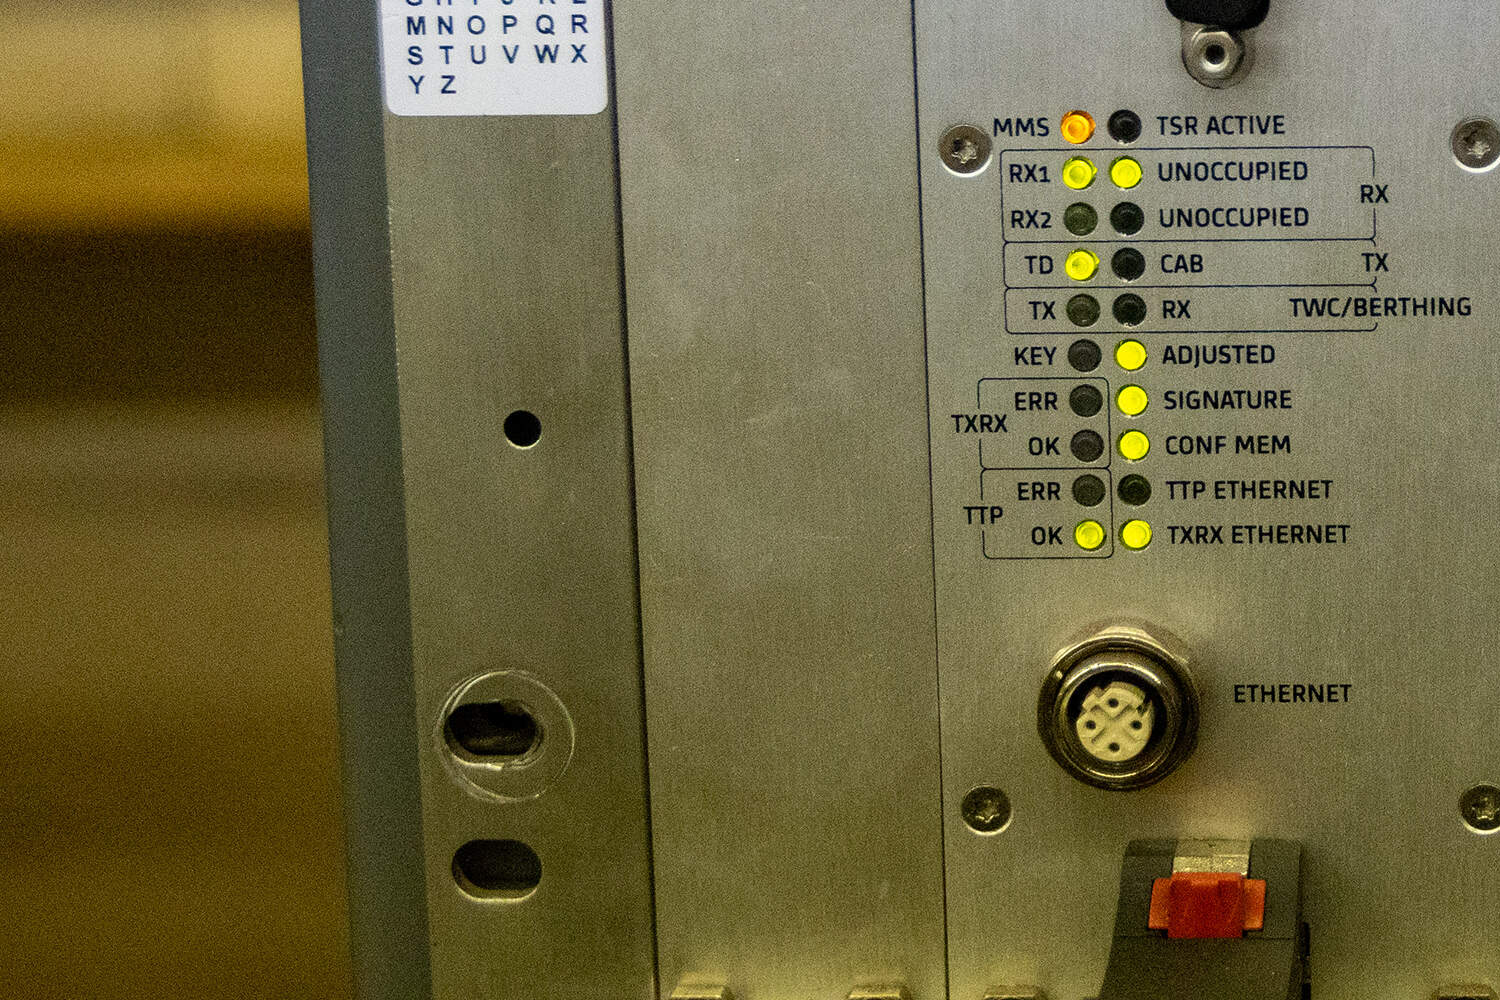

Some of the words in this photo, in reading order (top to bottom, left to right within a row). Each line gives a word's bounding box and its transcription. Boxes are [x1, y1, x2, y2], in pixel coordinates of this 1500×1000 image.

[993, 117, 1050, 137] MMS
[1157, 116, 1199, 136] TSR
[1206, 114, 1286, 136] ACTIVE
[1010, 164, 1051, 183] RX1
[1157, 162, 1308, 182] UNOCCUPIED
[1360, 184, 1389, 204] RX
[1010, 210, 1053, 229] RX2
[1159, 208, 1309, 228] UNOCCUPIED
[1025, 256, 1054, 275] TD
[1160, 254, 1204, 274] CAB
[1362, 253, 1389, 273] TX
[1029, 301, 1056, 321] TX
[1163, 300, 1191, 319] RX
[1290, 297, 1472, 318] TWC/BERTHING
[1014, 346, 1057, 366] KEY
[1162, 345, 1276, 369] ADJUSTED
[1014, 392, 1058, 411] ERR
[1164, 390, 1292, 410] SIGNATURE
[951, 414, 1008, 434] TXRX
[1028, 437, 1060, 456] OK
[1165, 435, 1227, 455] CONF
[1235, 435, 1292, 455] MEM
[1017, 482, 1061, 501] ERR
[1166, 480, 1207, 500] TTP
[1214, 480, 1333, 499] ETHERNET
[963, 506, 1004, 525] TTP
[1031, 526, 1063, 546] OK
[1168, 525, 1224, 545] TXRX
[1231, 524, 1350, 545] ETHERNET
[1234, 684, 1353, 703] ETHERNET
